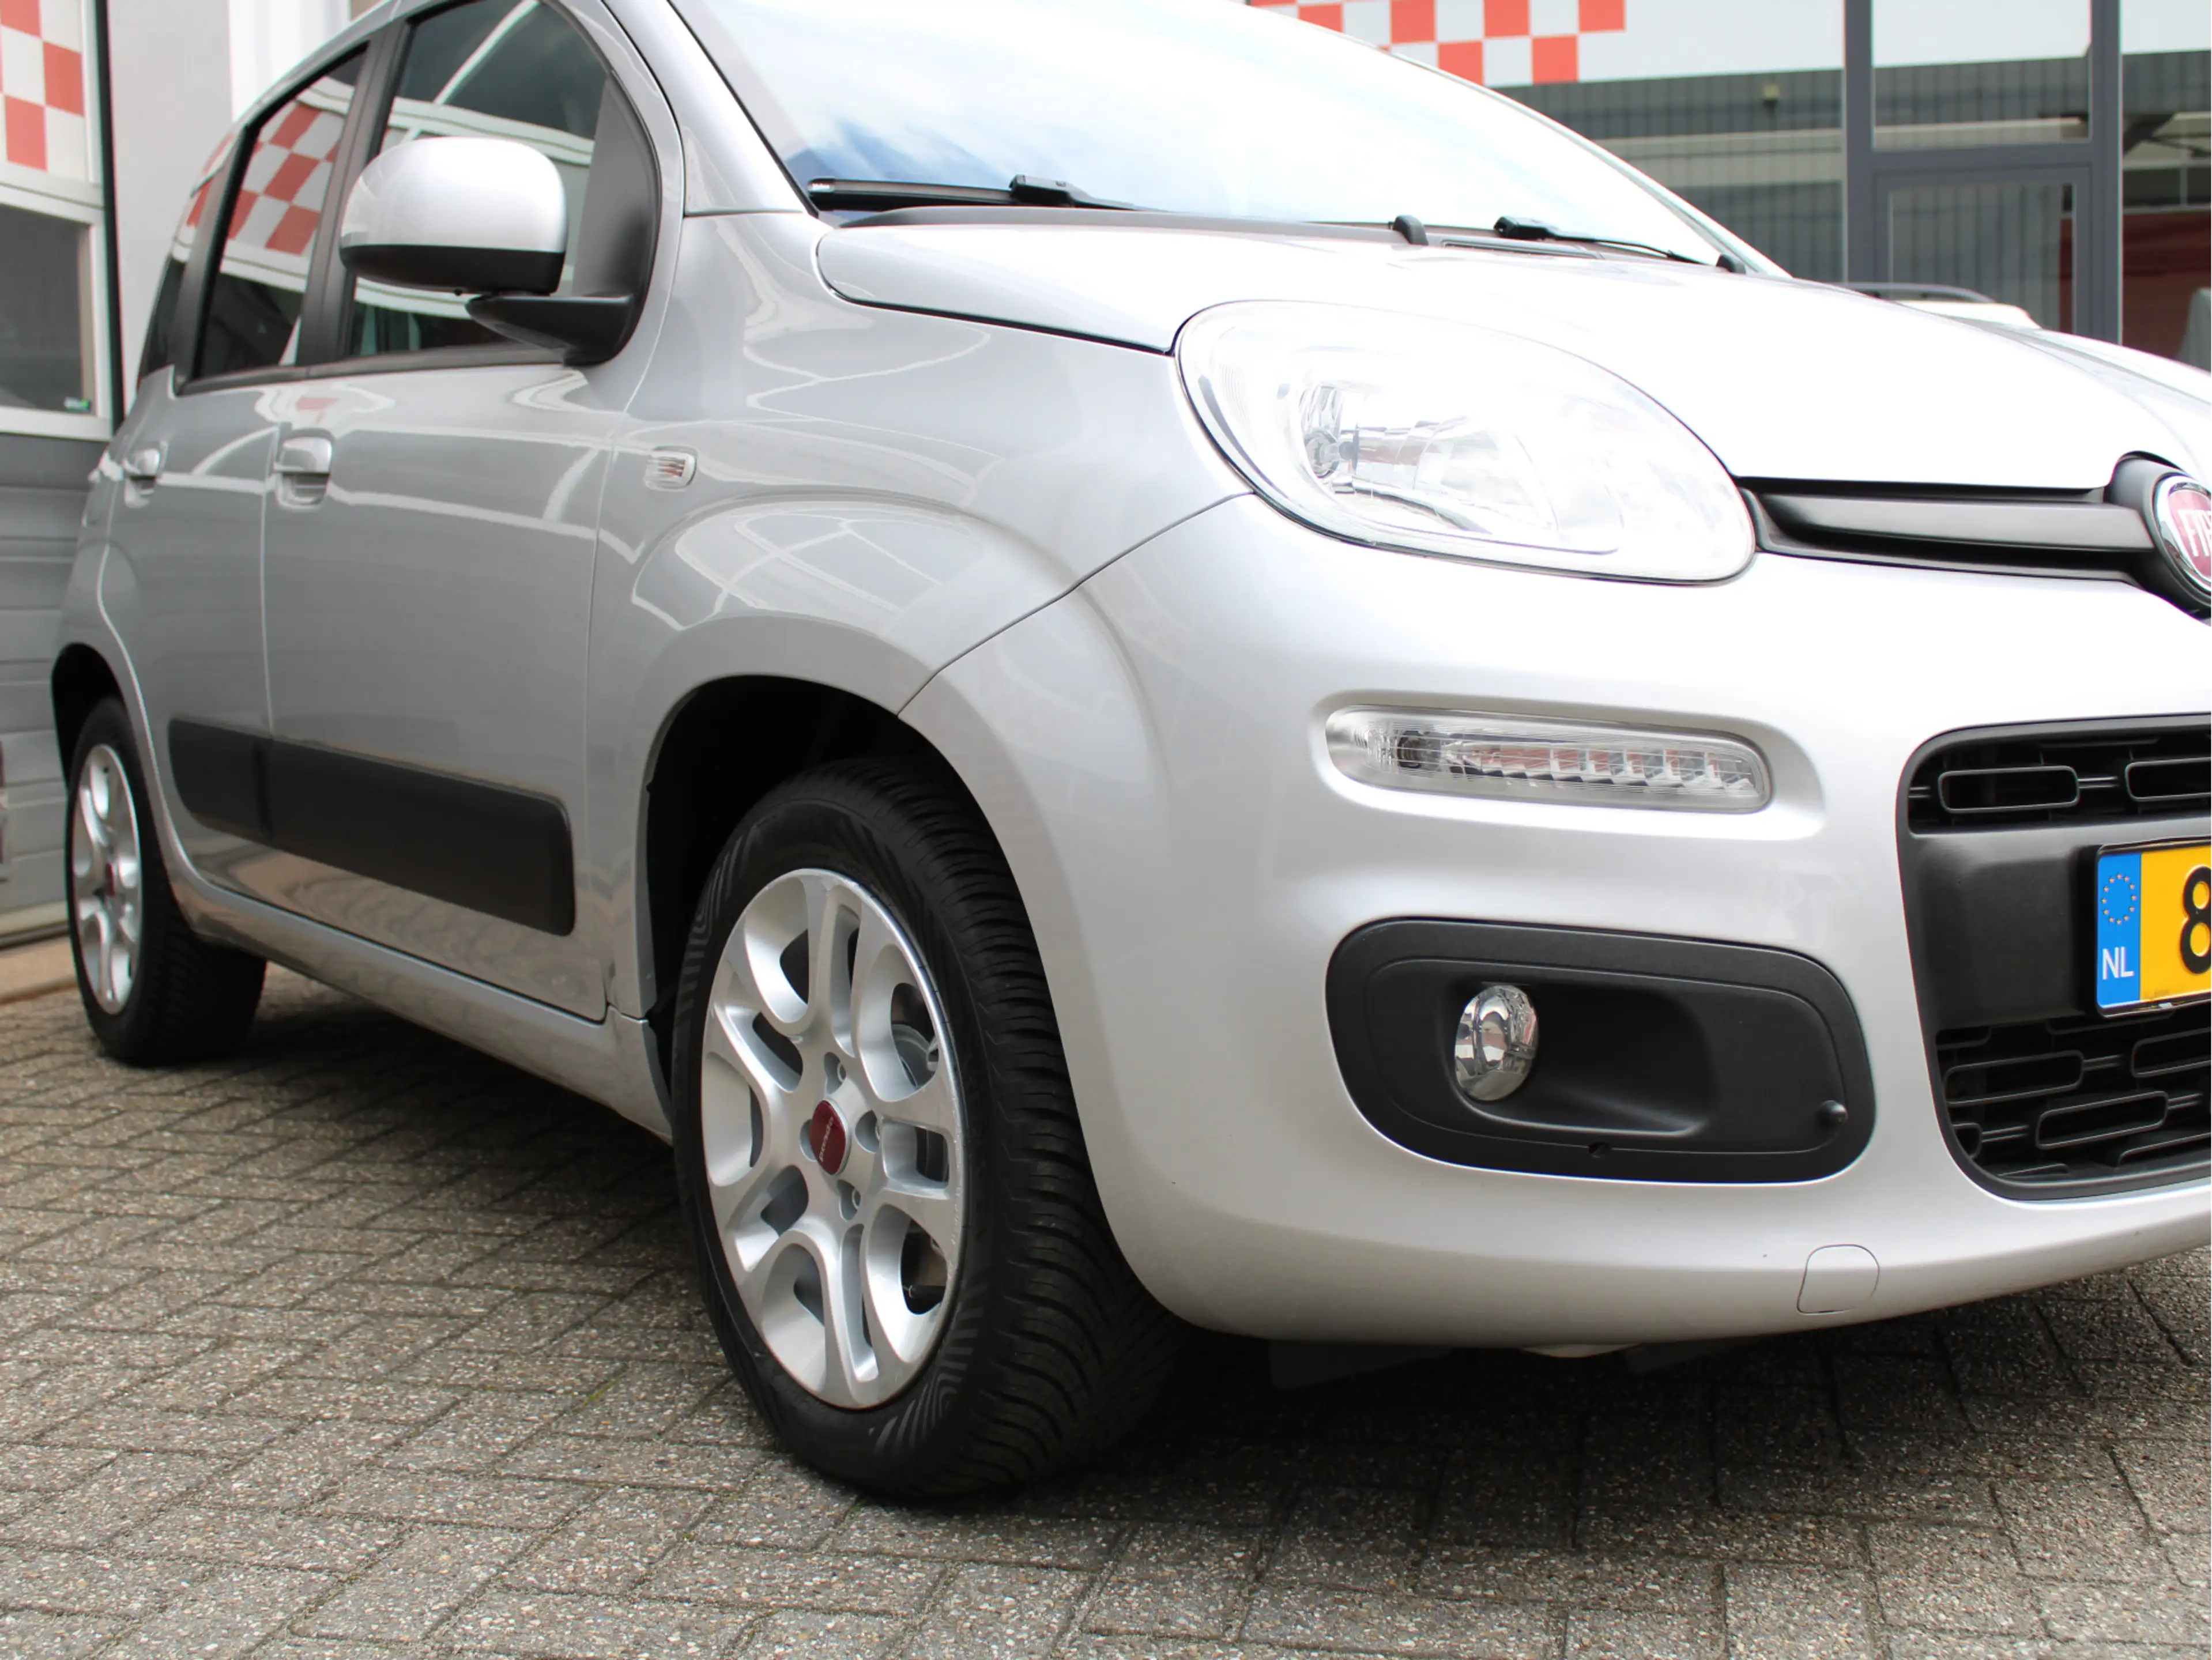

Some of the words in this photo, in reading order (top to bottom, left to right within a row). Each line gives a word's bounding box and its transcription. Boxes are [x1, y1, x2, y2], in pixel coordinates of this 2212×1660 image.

[2176, 509, 2211, 557] FIA
[2180, 865, 2211, 974] 8
[2102, 946, 2134, 980] NL
